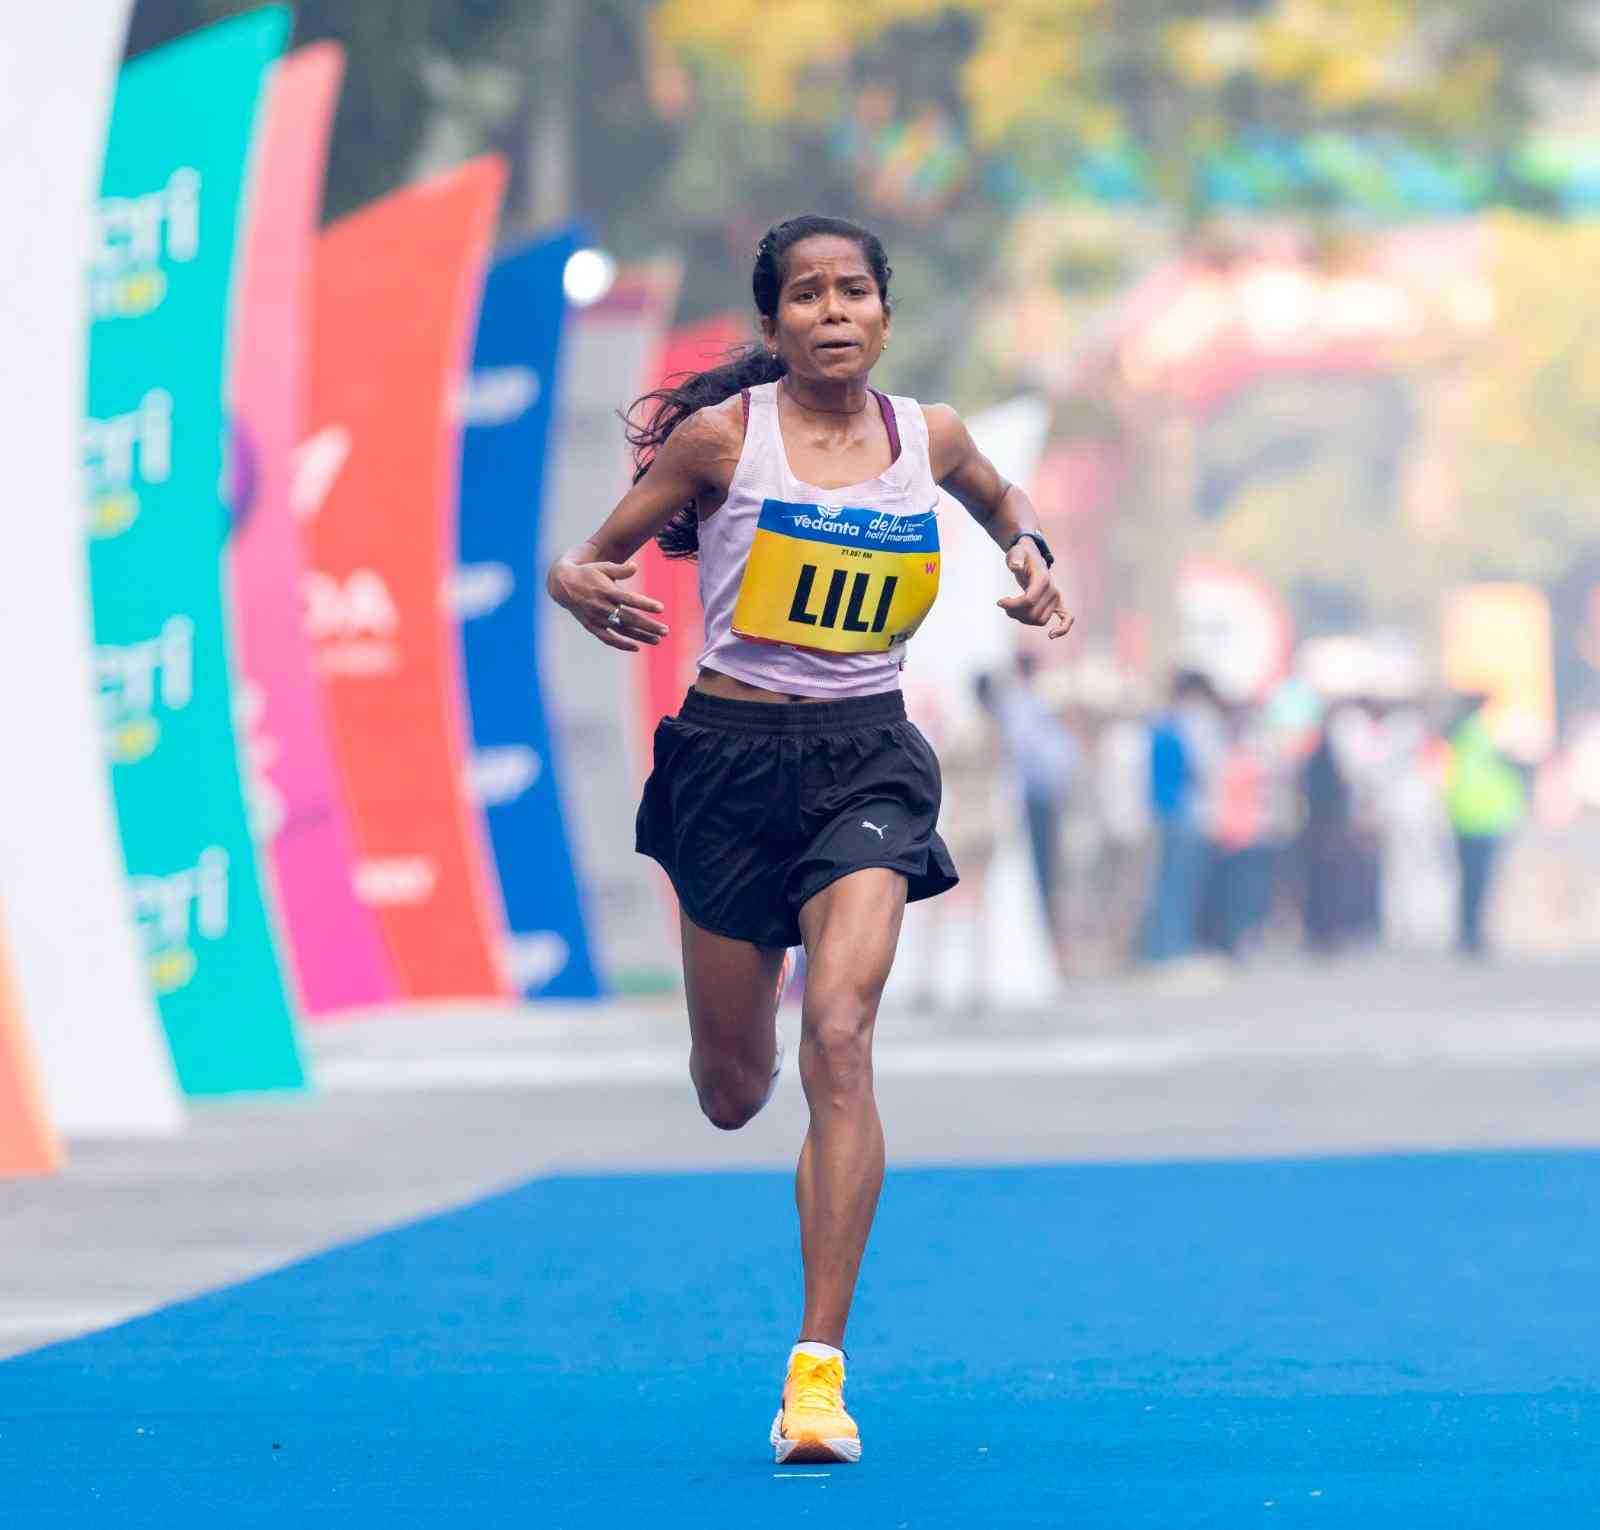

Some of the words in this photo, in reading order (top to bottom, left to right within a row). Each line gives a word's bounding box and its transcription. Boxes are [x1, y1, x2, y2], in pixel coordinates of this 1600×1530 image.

[794, 516, 860, 537] vedanta
[865, 530, 884, 540] half
[886, 533, 924, 543] marathon
[869, 512, 908, 543] delhi
[925, 562, 936, 574] W
[788, 563, 898, 633] LILI
